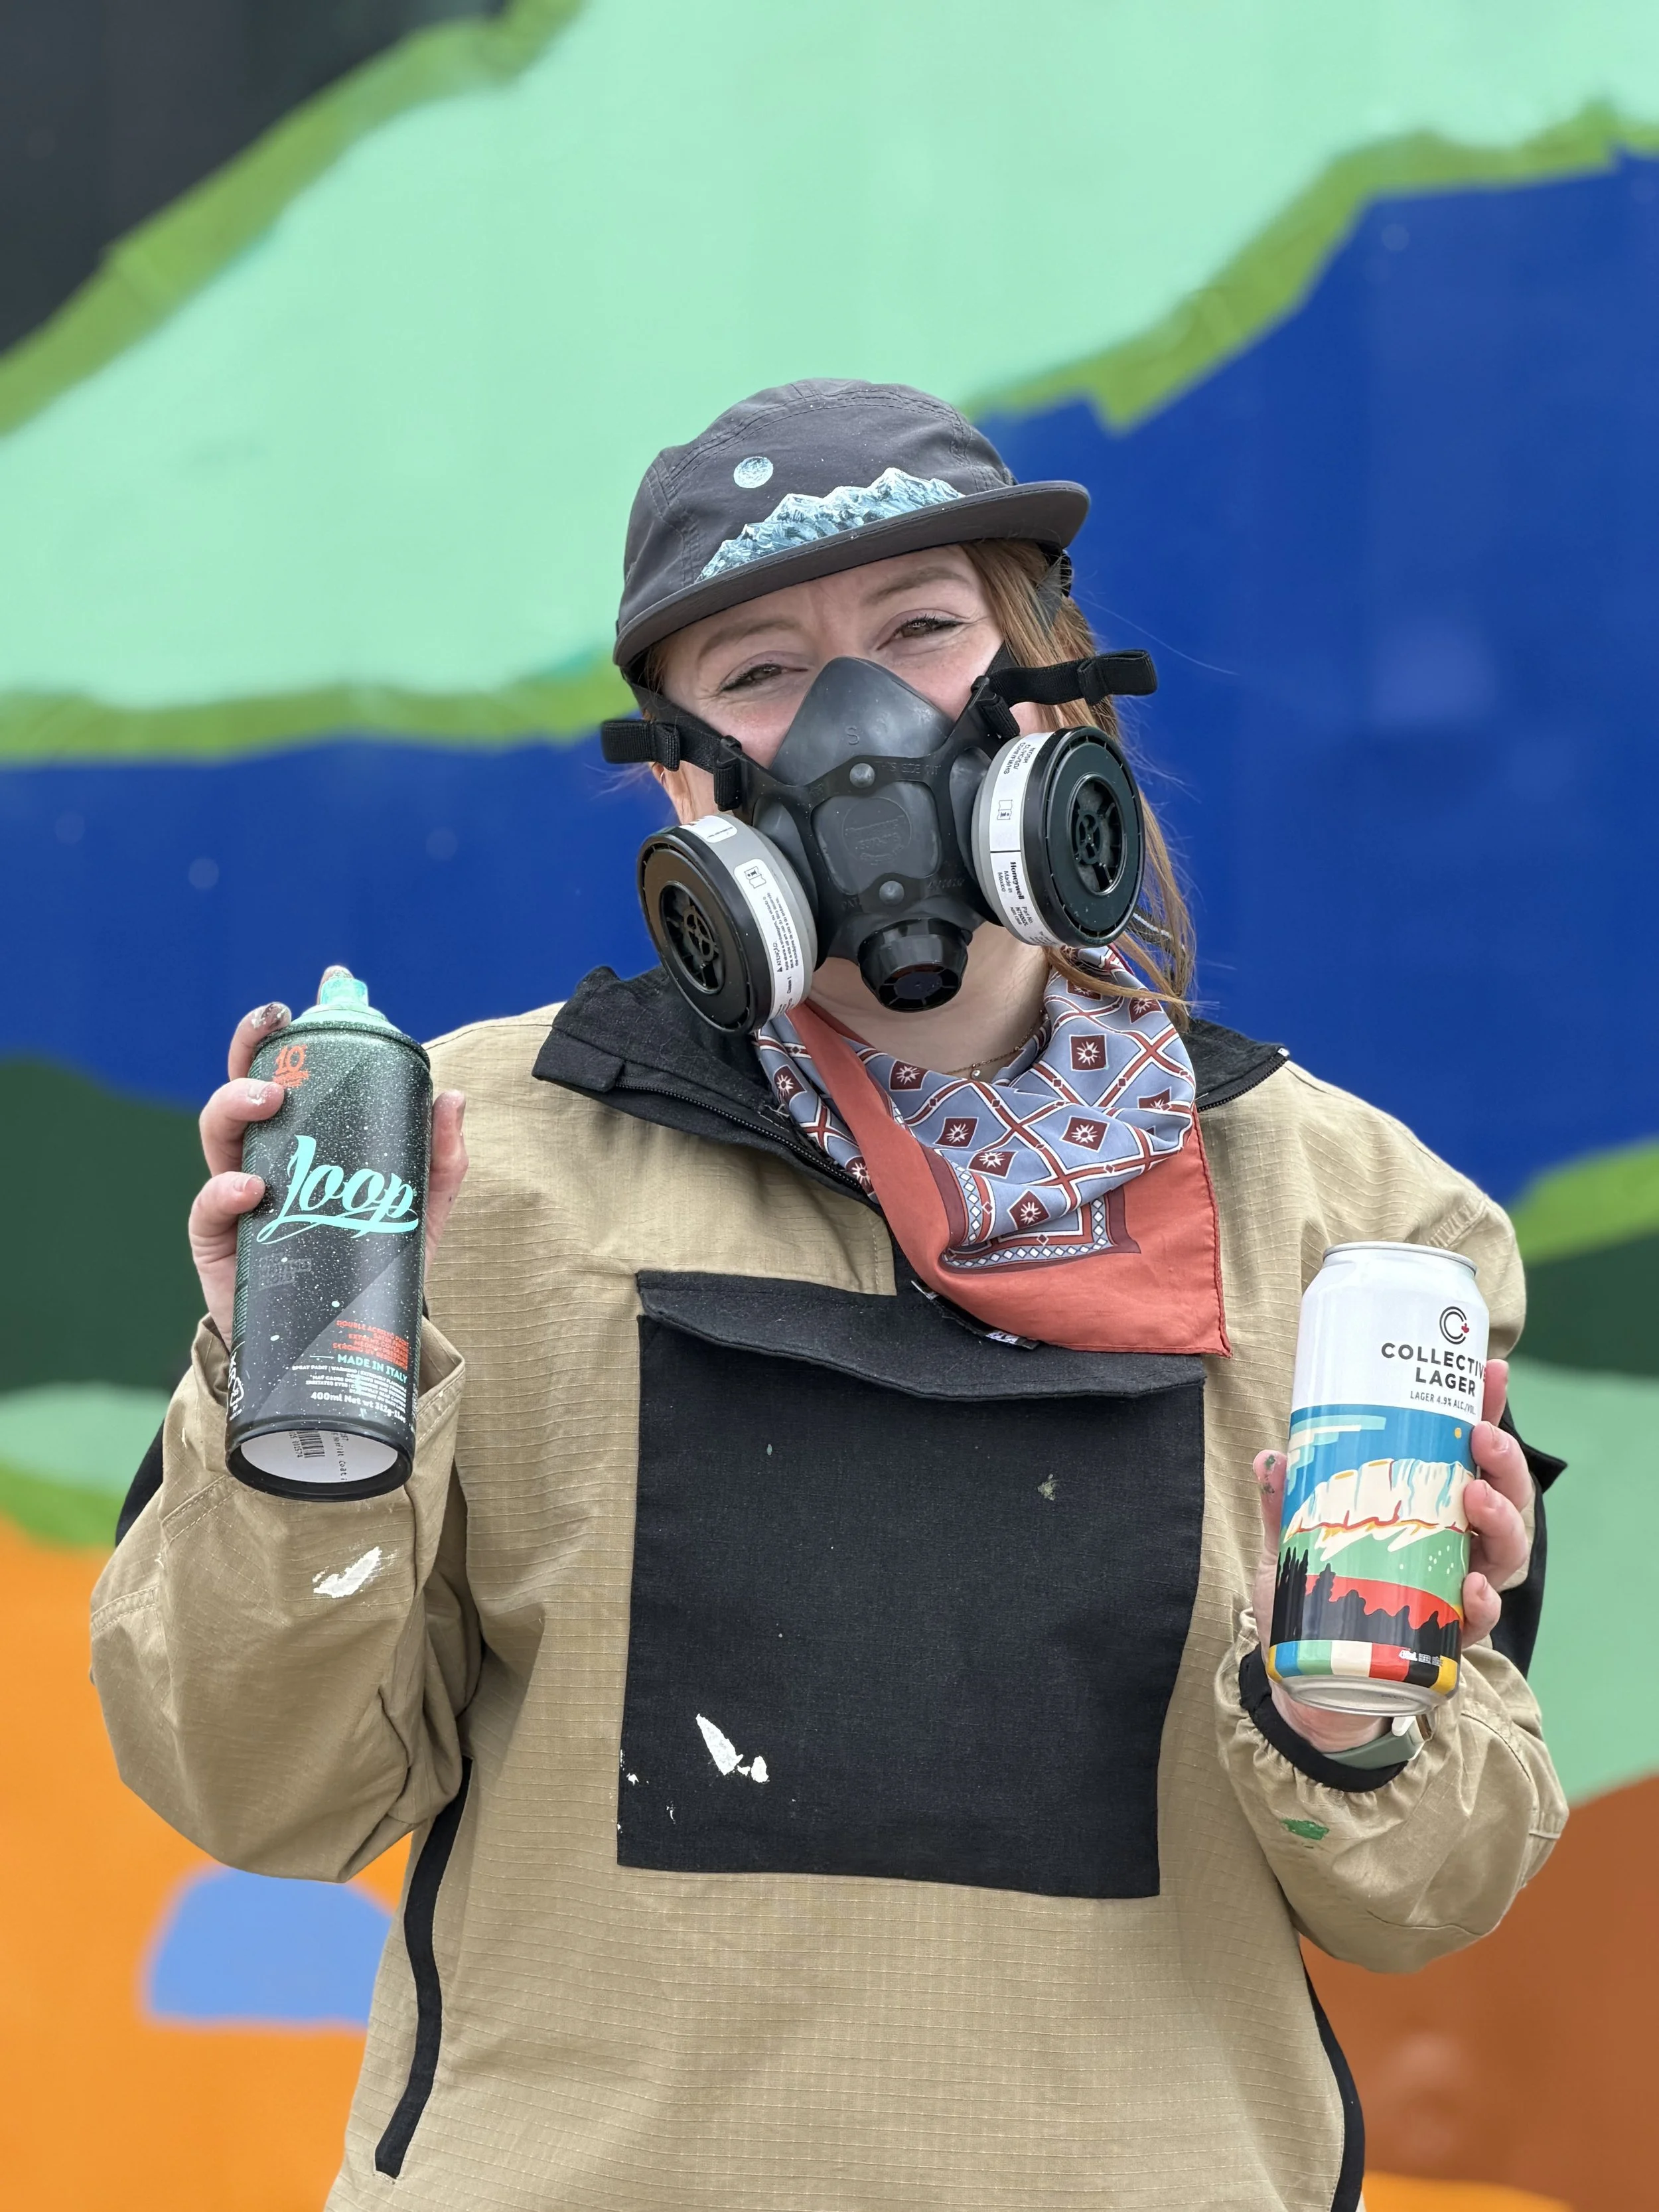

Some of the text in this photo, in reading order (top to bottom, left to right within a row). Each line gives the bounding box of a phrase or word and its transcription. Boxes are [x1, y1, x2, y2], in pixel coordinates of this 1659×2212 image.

[1010, 861, 1025, 900] Honeywell
[257, 1134, 419, 1244] Loop
[337, 1354, 370, 1368] MADE
[372, 1361, 384, 1372] IN
[386, 1366, 407, 1383] ITALY
[1415, 1367, 1476, 1397] LAGER
[311, 1391, 342, 1402] 400ml
[344, 1394, 361, 1405] Net
[362, 1399, 374, 1408] wt
[1410, 1390, 1434, 1403] LAGER
[1436, 1396, 1451, 1407] 4.9%
